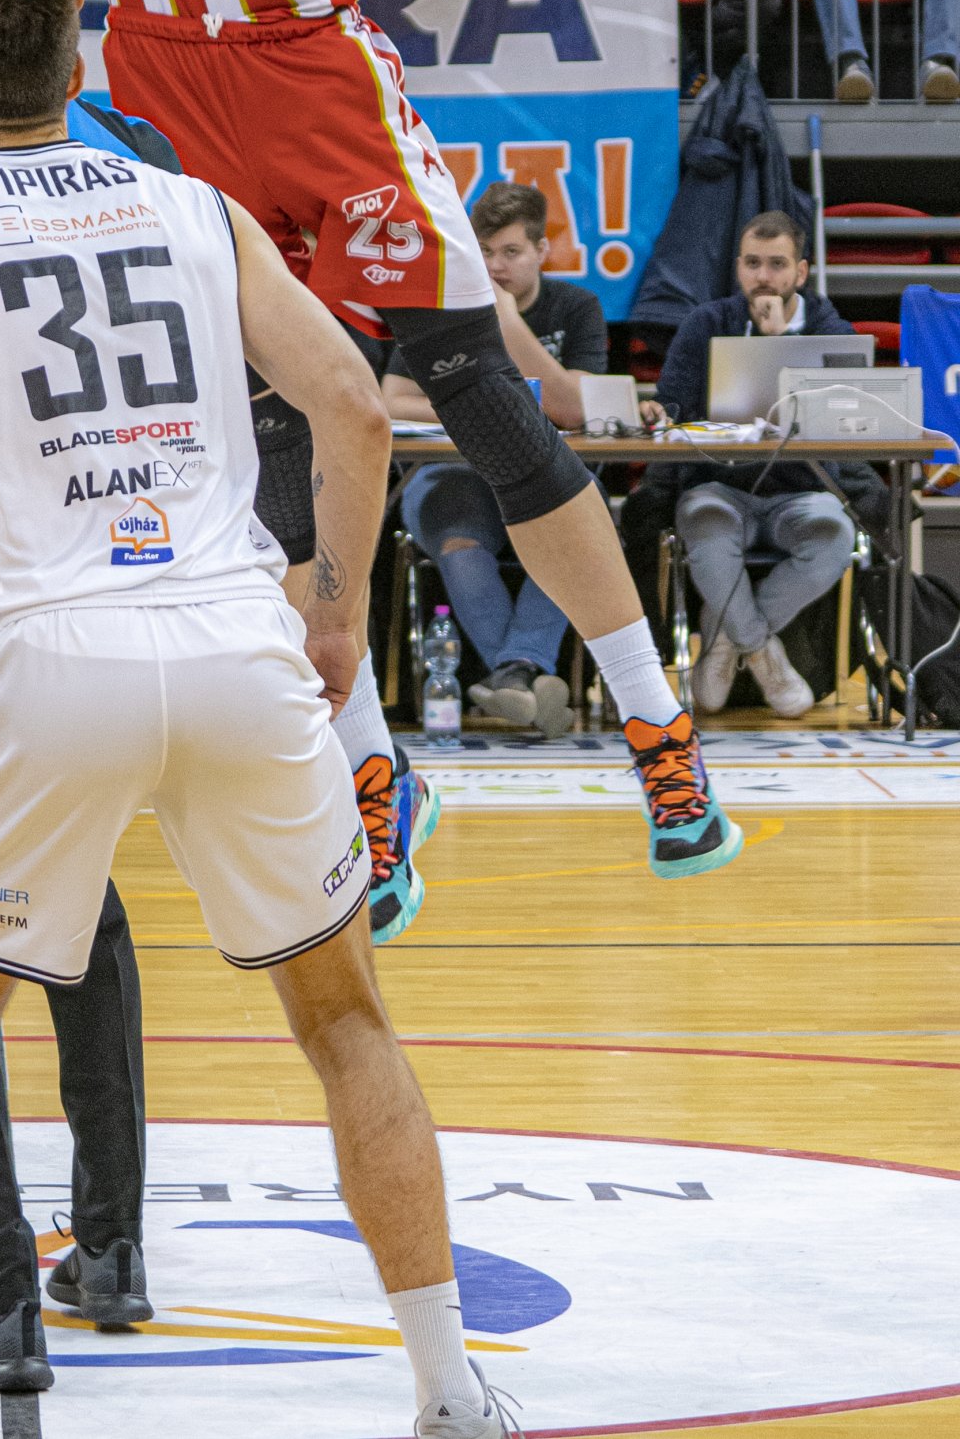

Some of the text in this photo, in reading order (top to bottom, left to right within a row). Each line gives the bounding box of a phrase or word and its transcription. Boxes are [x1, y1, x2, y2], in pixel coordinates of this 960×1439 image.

[0, 202, 158, 233] EISSMANN
[352, 194, 384, 215] MOL
[36, 219, 161, 243] GROUP AUTOMOTIVE
[345, 215, 425, 263] 25
[40, 421, 195, 458] BLADESPORT
[169, 437, 196, 448] power
[64, 460, 202, 507] ALANEX KFT
[7, 915, 29, 930] FM
